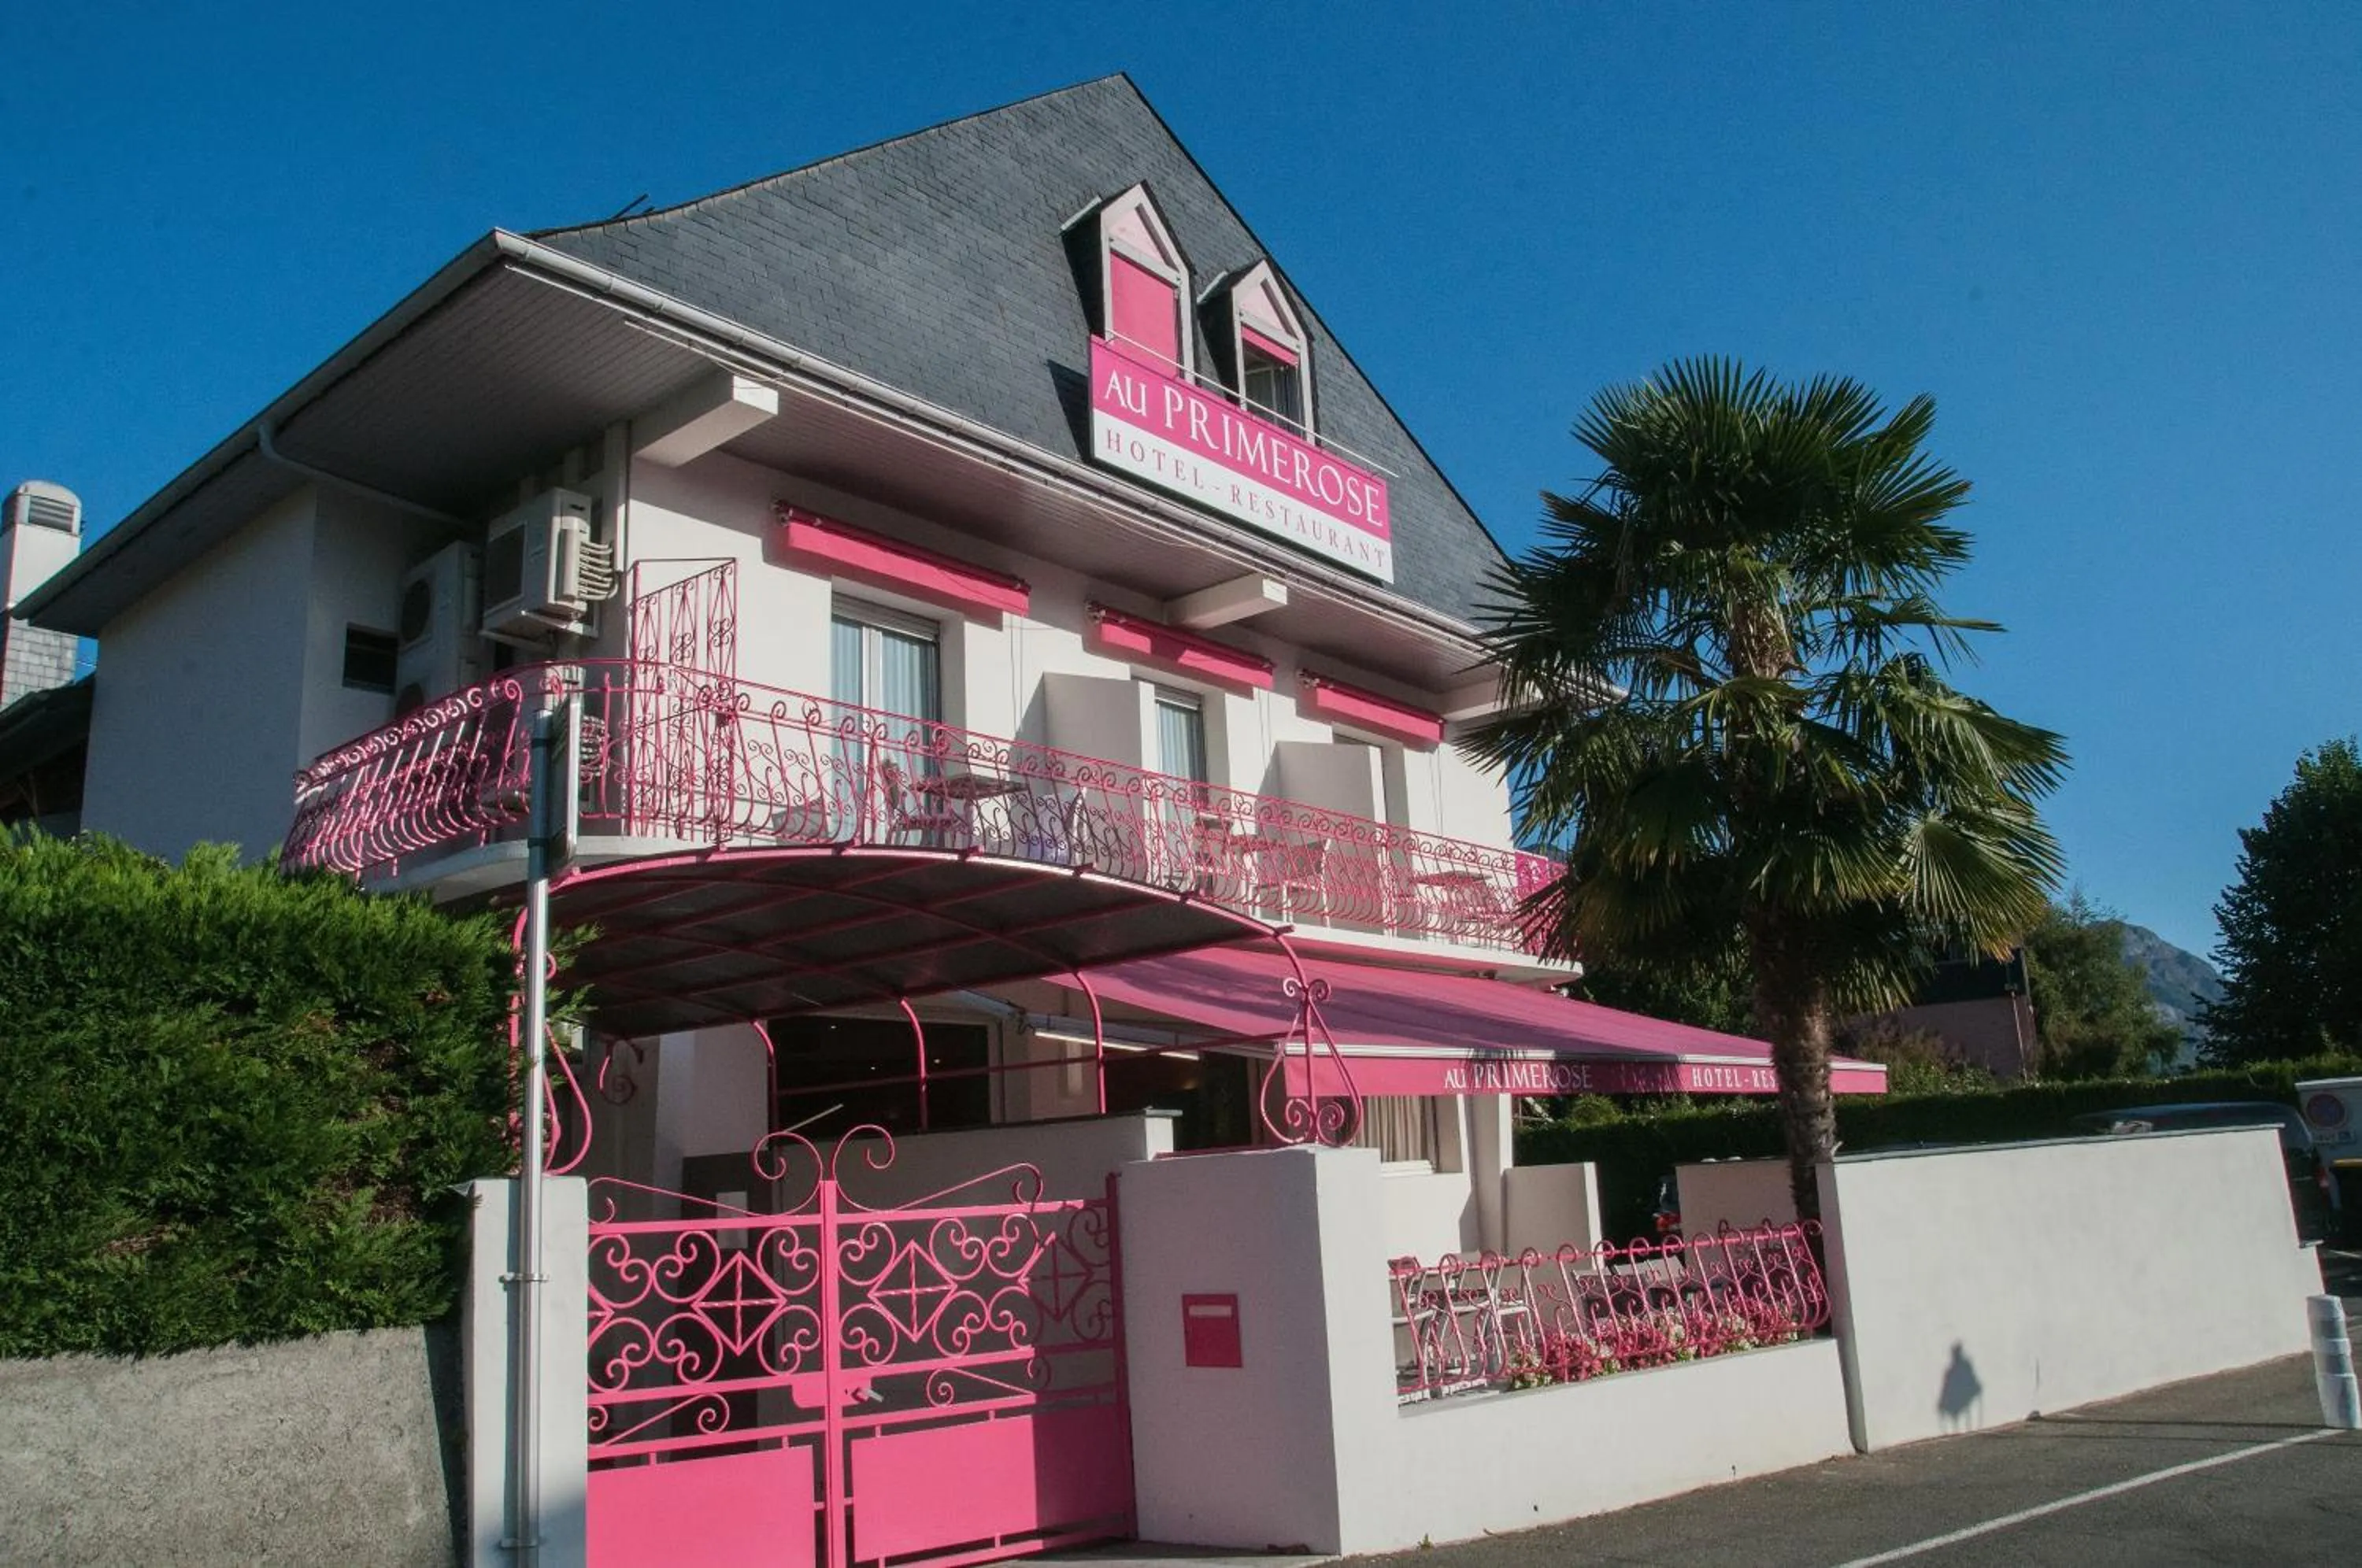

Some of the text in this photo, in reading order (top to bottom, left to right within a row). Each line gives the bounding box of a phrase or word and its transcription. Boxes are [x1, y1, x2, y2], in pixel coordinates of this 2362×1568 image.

[1104, 368, 1383, 528] AU PRIMEROSE
[1444, 1061, 1594, 1089] AU PRIMEROSE
